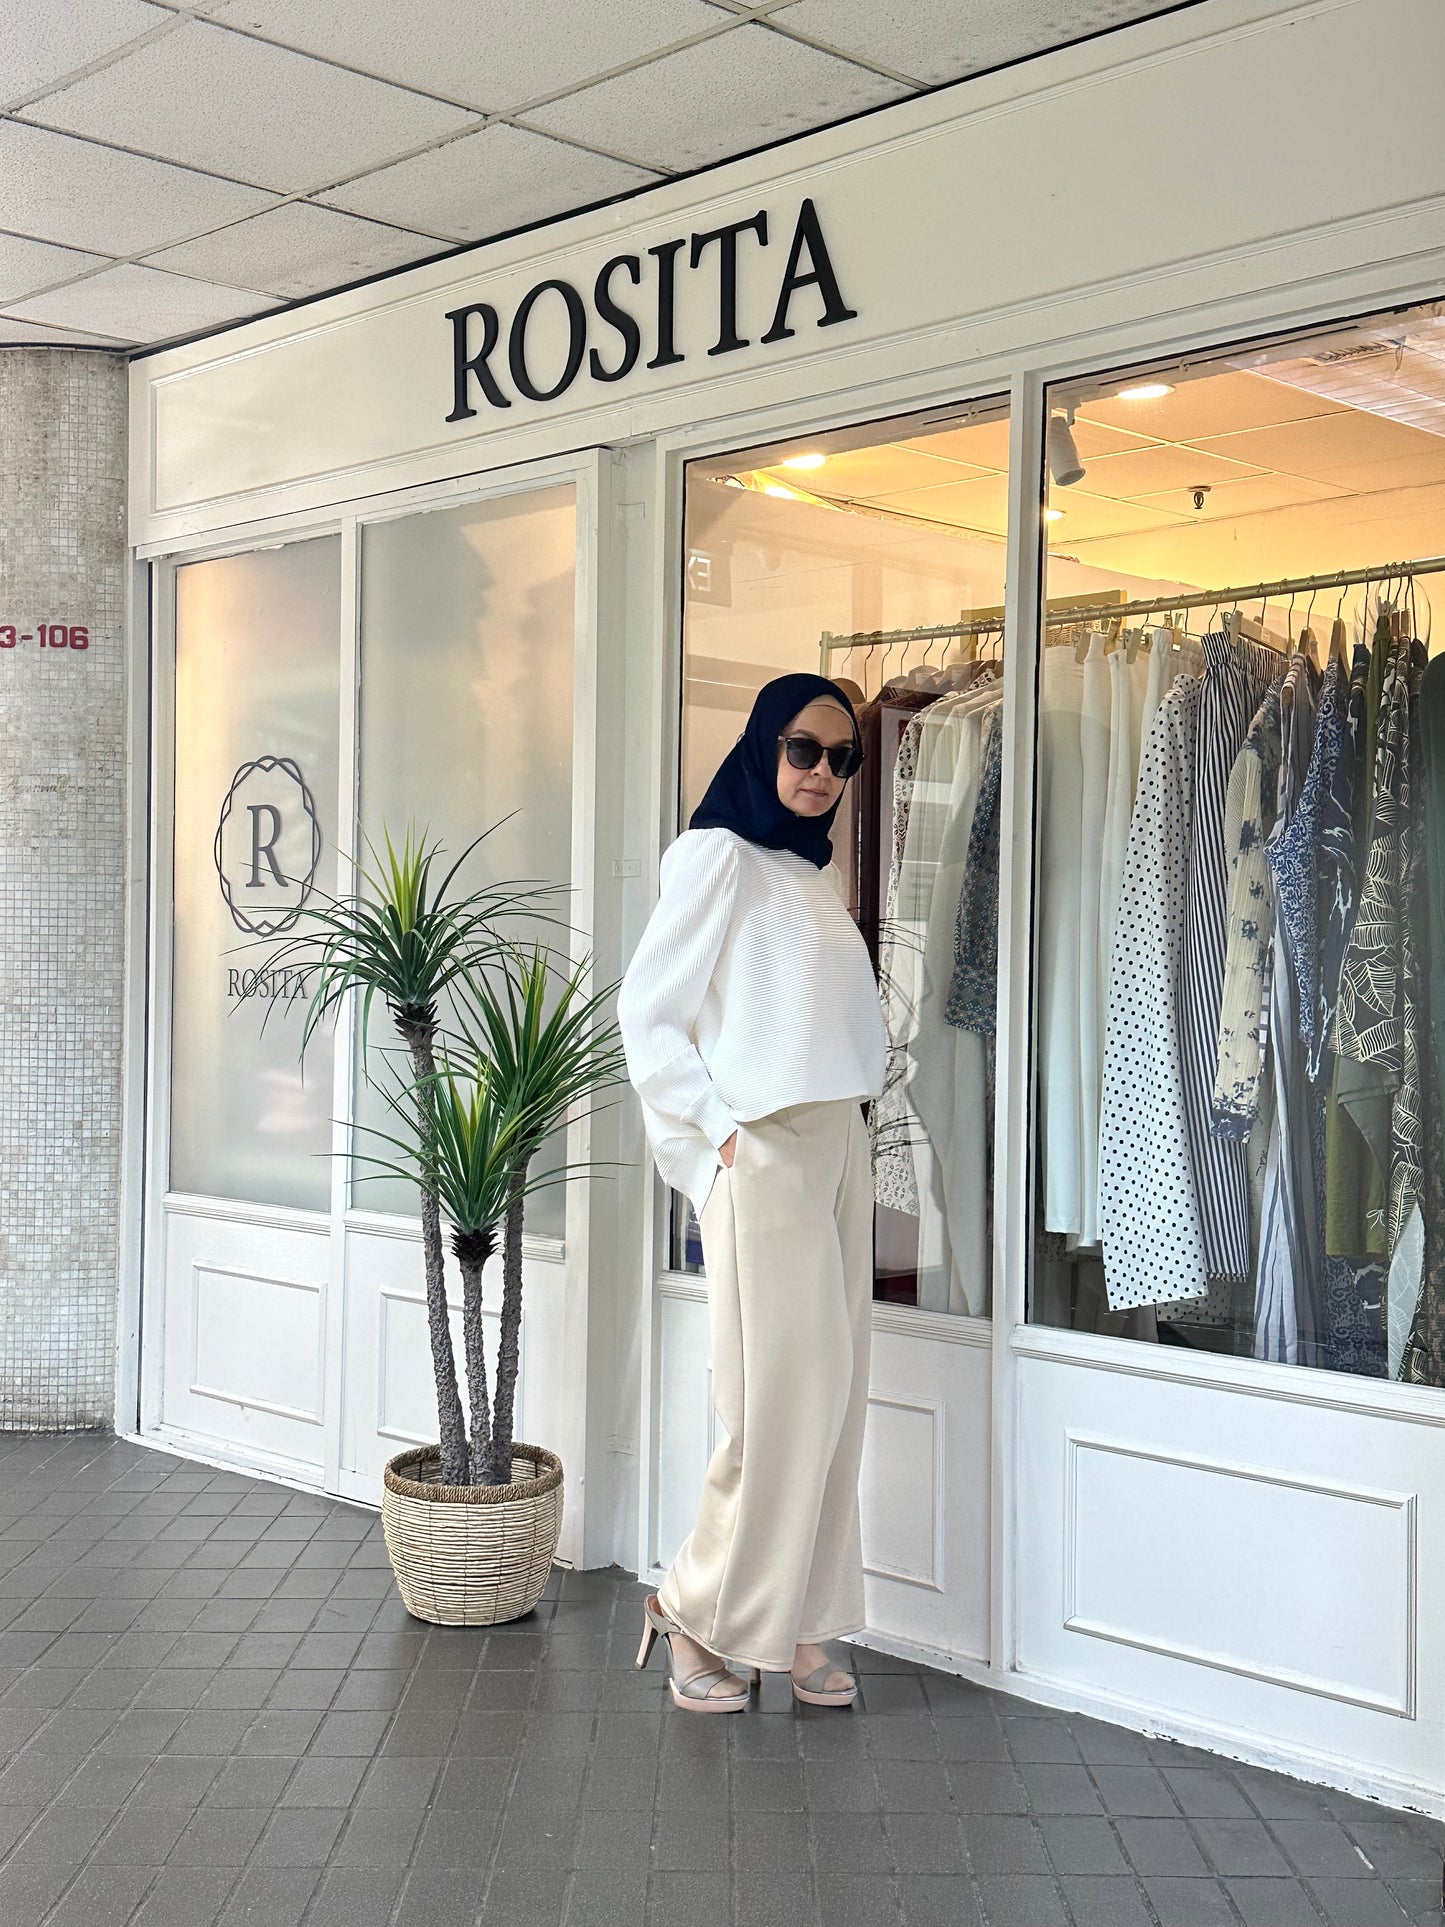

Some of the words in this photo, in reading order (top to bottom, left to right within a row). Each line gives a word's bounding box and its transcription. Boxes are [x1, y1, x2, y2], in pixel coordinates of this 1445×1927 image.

[444, 197, 858, 423] ROSITA
[0, 624, 89, 650] 3-106
[245, 804, 289, 888] R
[227, 968, 309, 1000] ROSITA
